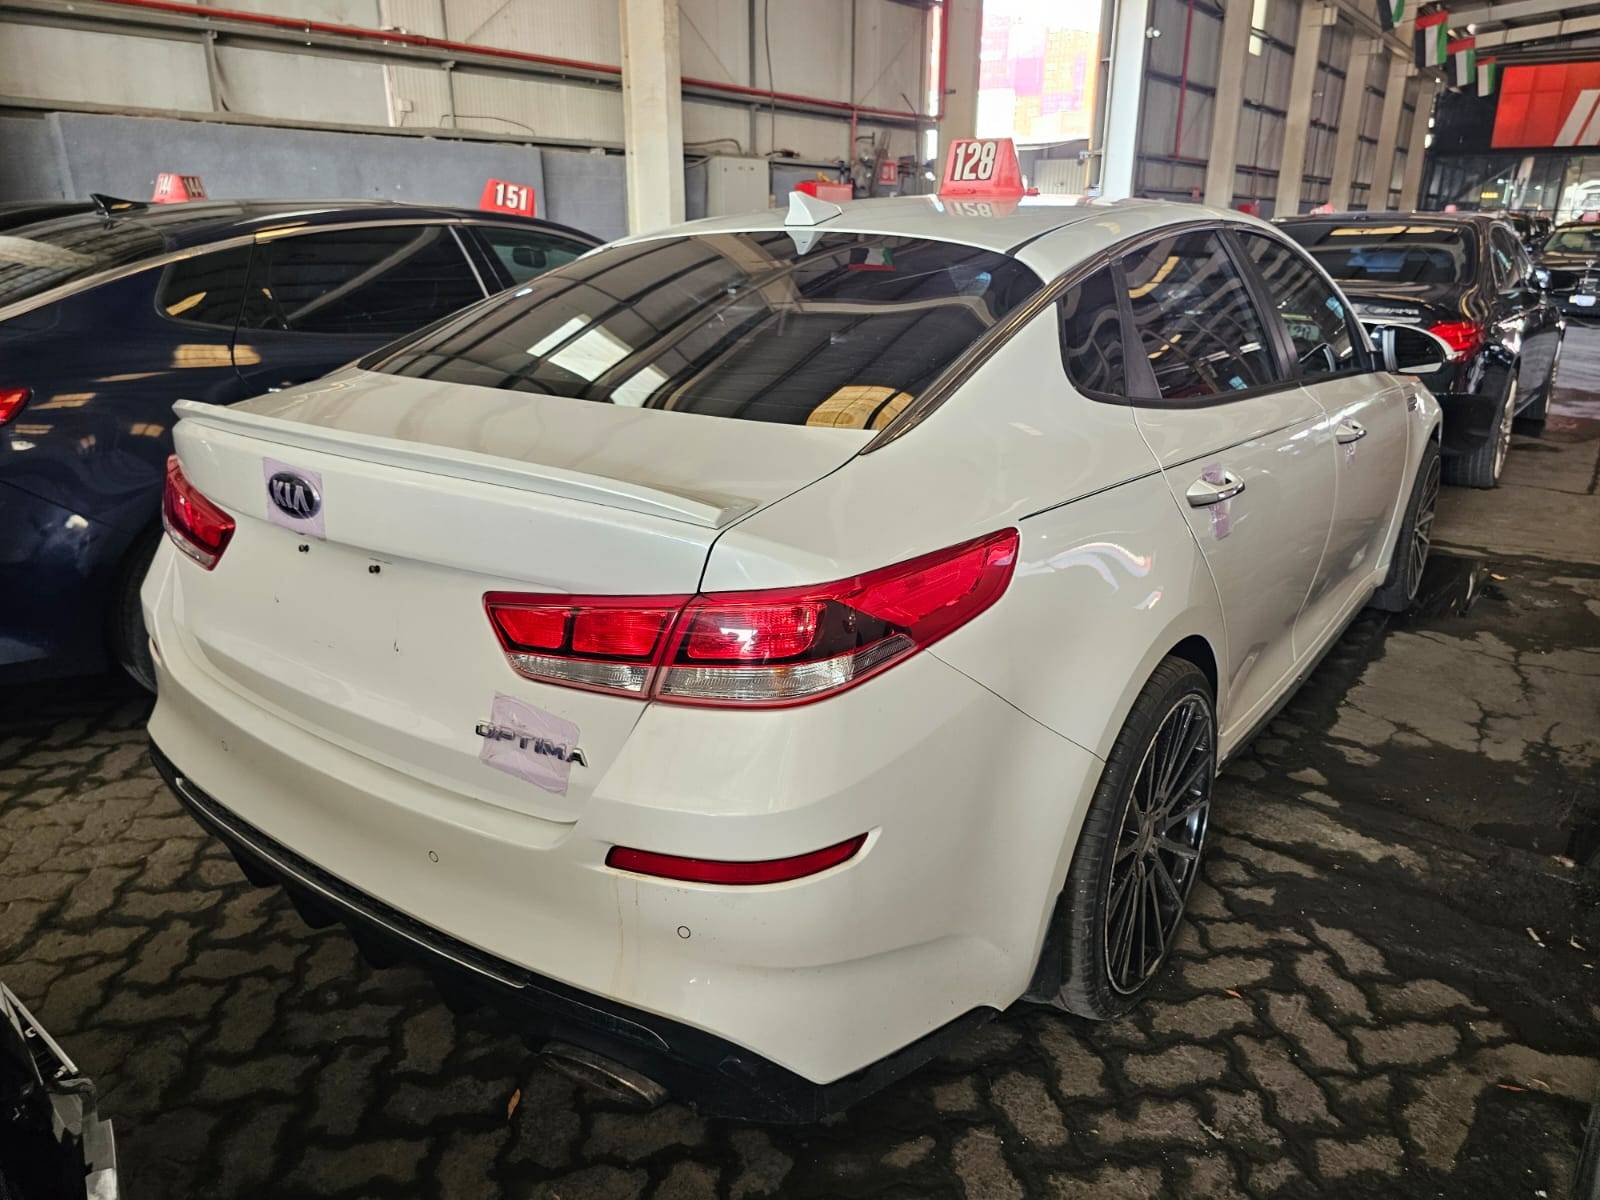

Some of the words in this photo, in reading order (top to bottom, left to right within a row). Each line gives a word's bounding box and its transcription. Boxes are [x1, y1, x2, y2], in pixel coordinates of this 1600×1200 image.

[953, 142, 996, 180] 128
[495, 183, 528, 211] 151
[272, 479, 311, 512] KIA
[475, 720, 588, 768] OPTIMA
